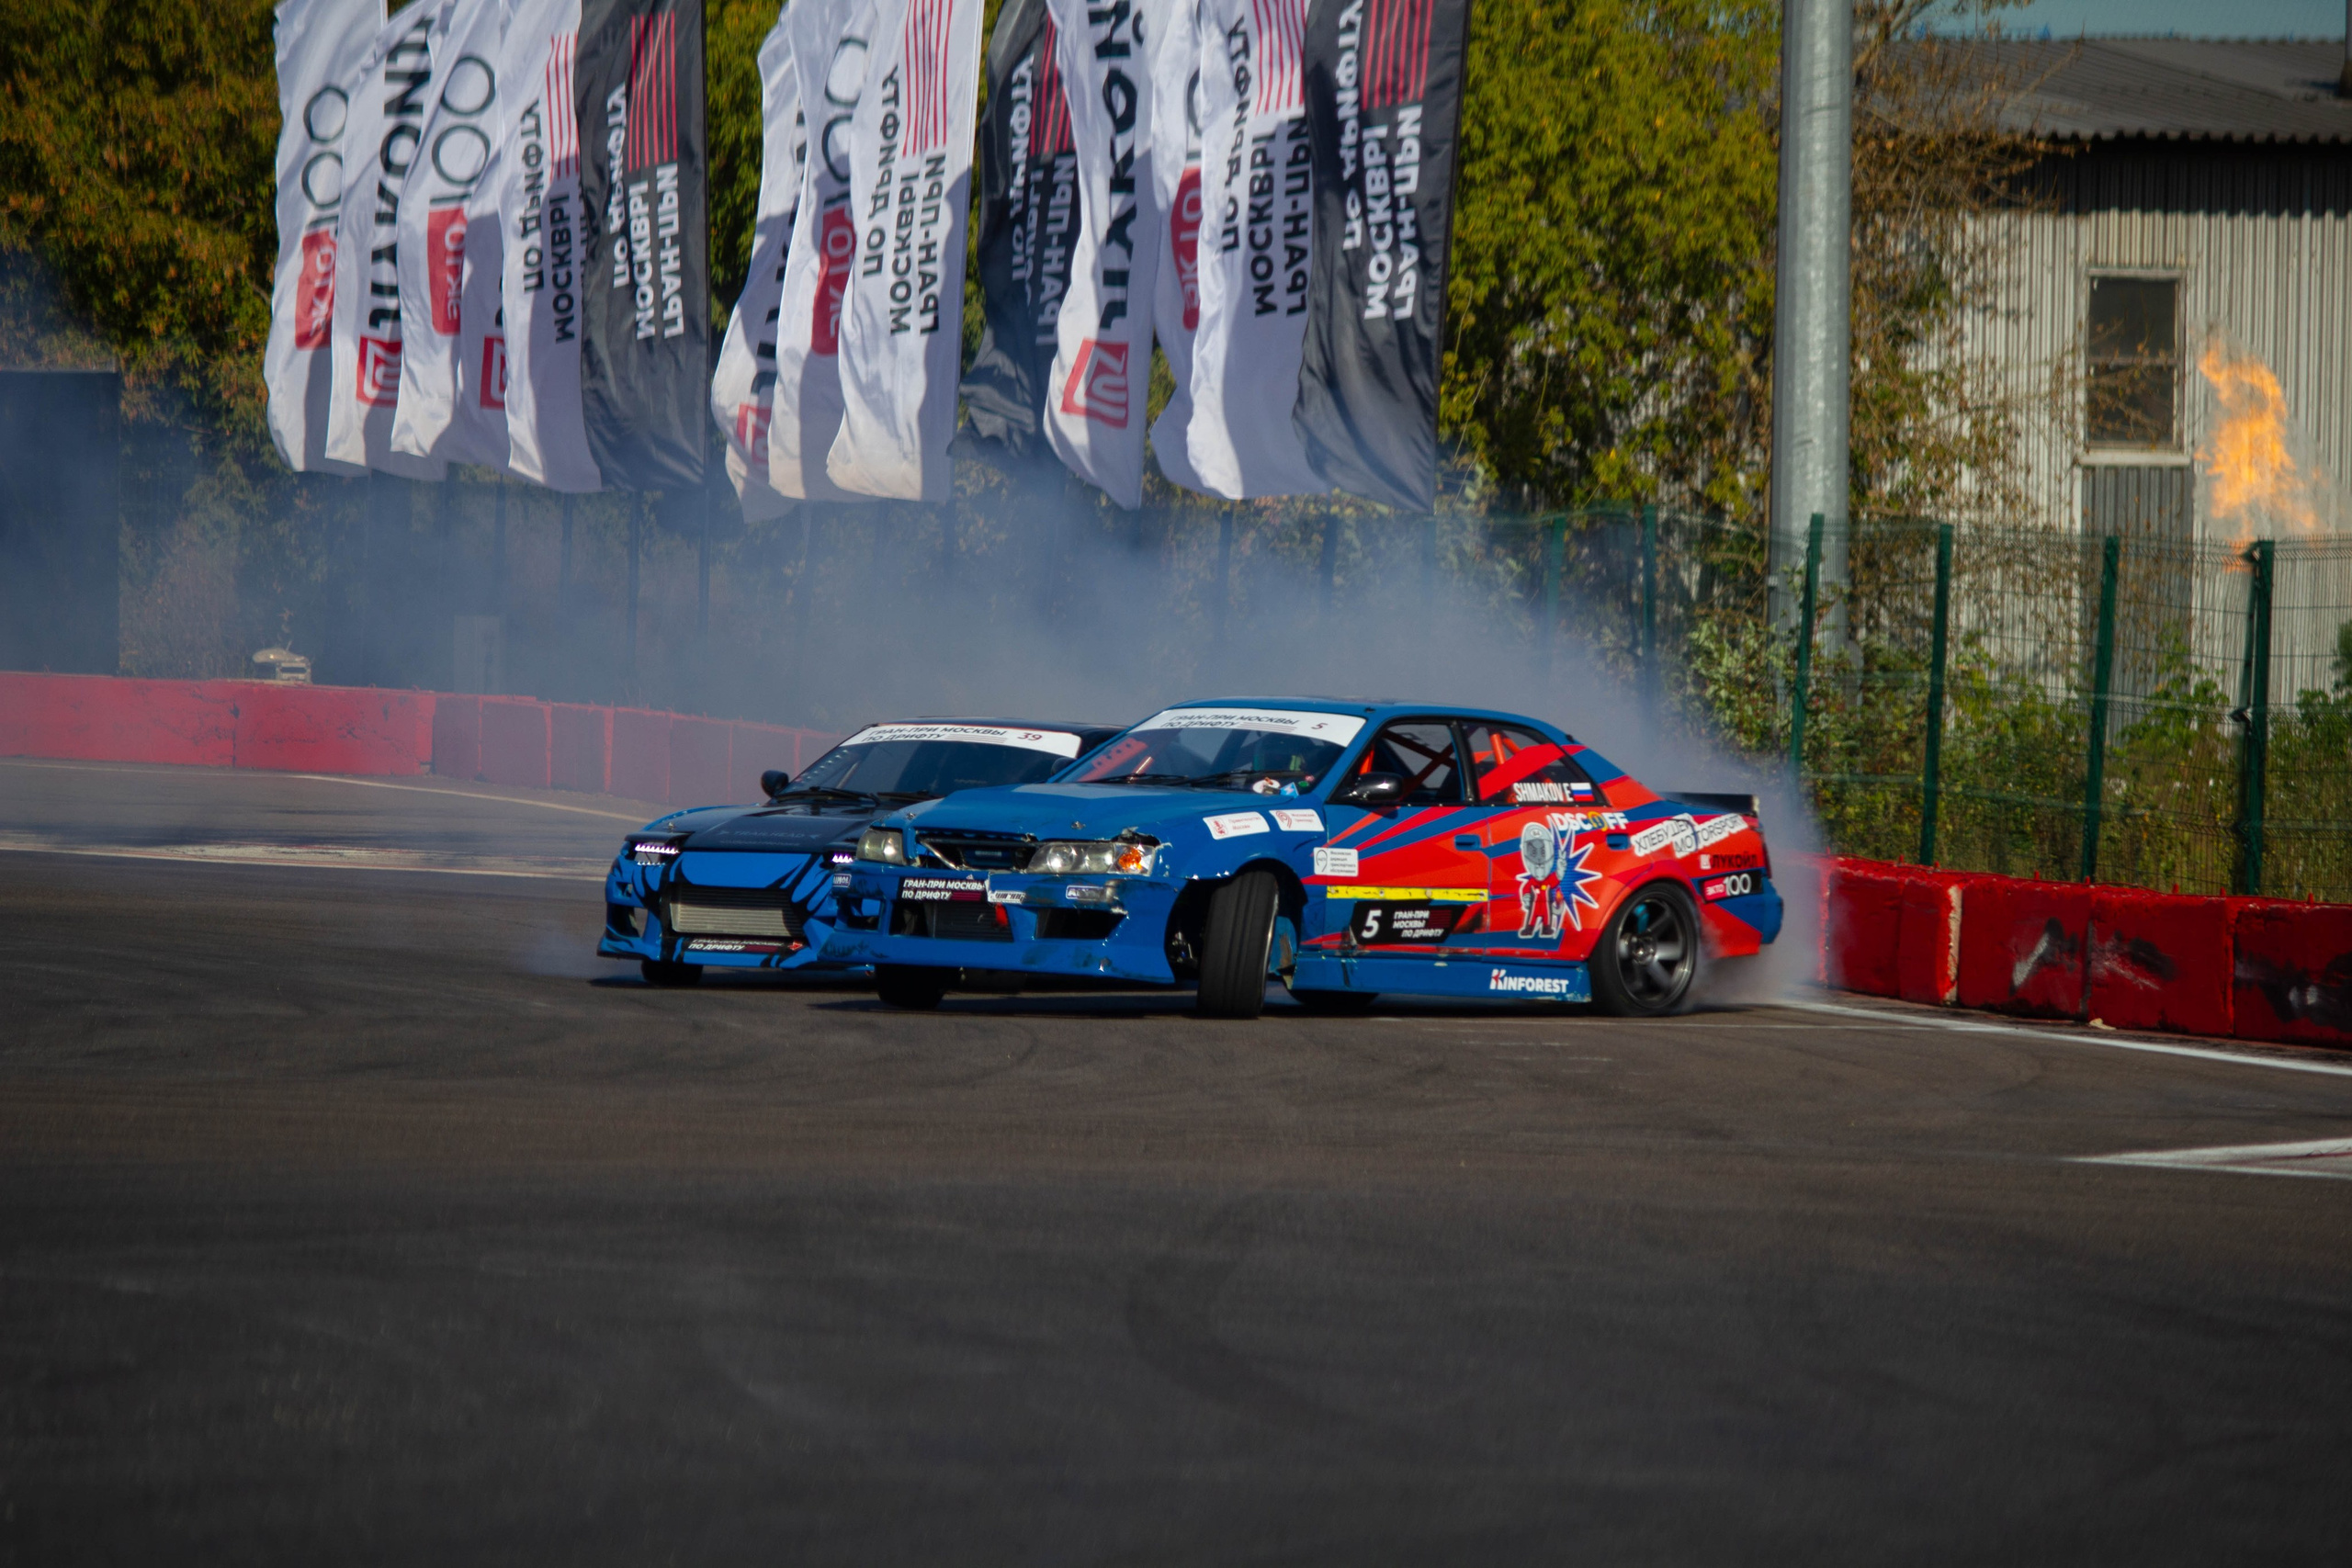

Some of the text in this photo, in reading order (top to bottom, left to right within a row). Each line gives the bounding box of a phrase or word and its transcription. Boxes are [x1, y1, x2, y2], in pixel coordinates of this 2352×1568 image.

[1017, 732, 1043, 742] 39
[1513, 783, 1565, 802] SHMAKOV
[1712, 851, 1758, 868] ЛУКОЙЛ
[903, 879, 946, 889] ГРАН-ПРИ
[1724, 874, 1752, 897] 100
[901, 890, 952, 900] ПО ДРИФТУ
[1394, 909, 1430, 919] ГРАН-ПРИ
[1362, 909, 1382, 938] 5
[1393, 919, 1426, 929] МОСКВЫ
[1401, 929, 1444, 938] ПО ДРИФТУ
[1489, 968, 1569, 993] KINFOREST
